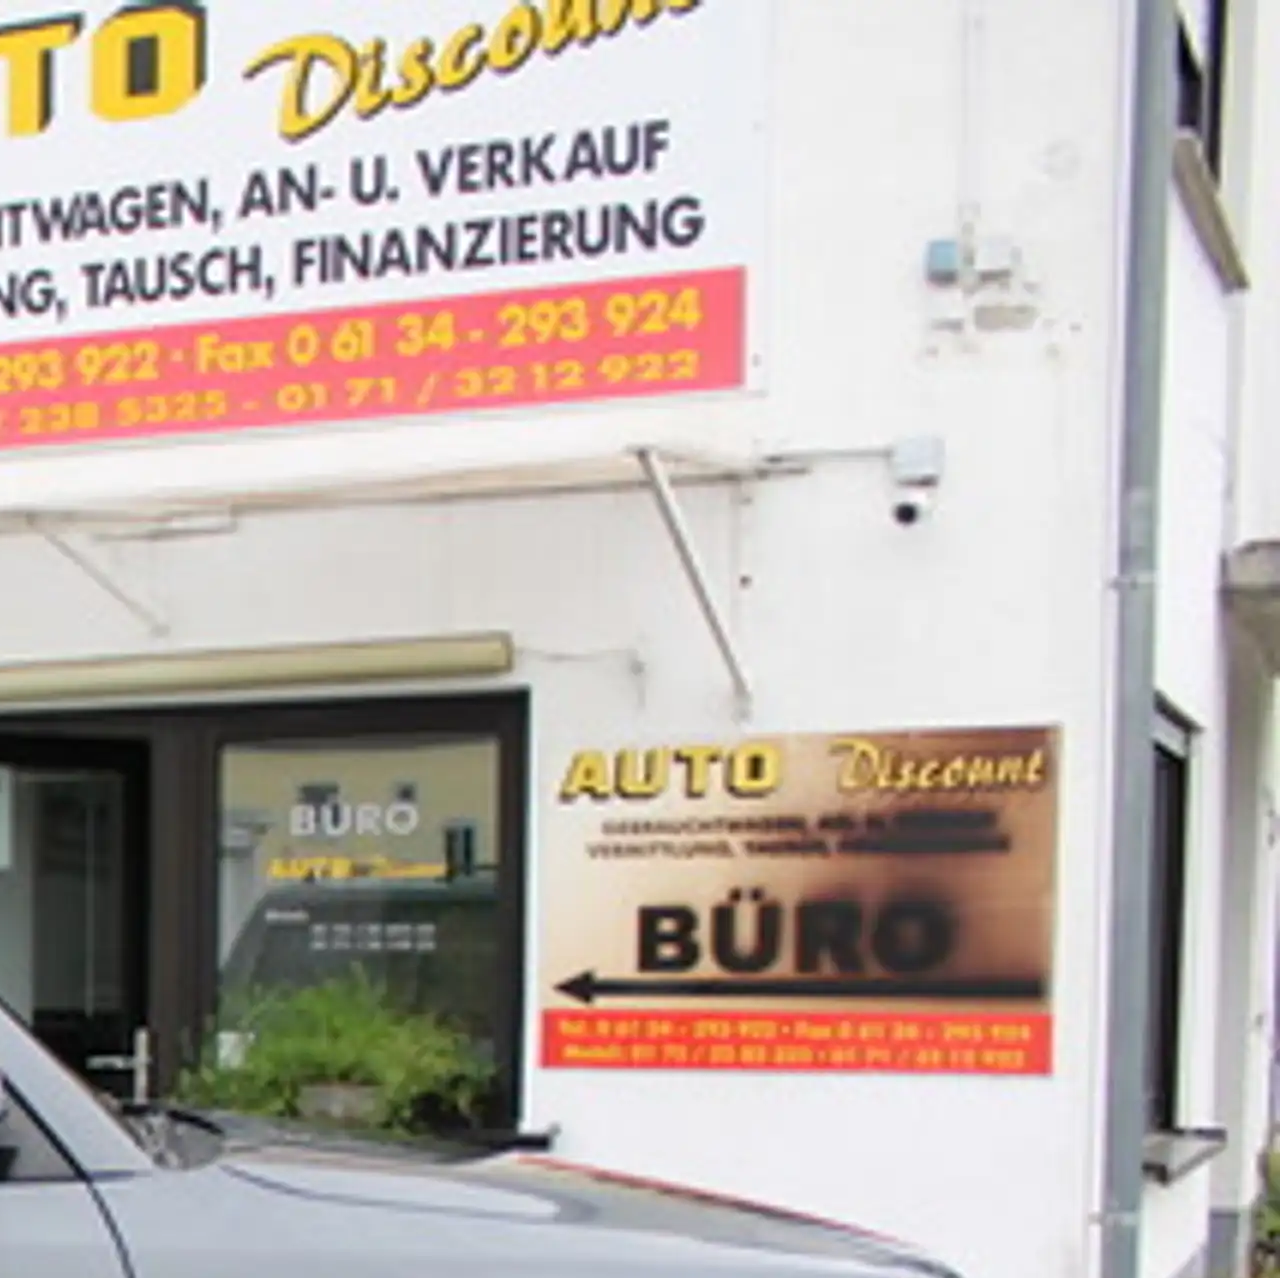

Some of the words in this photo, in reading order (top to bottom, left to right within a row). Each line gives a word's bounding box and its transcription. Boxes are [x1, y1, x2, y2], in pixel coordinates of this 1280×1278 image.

[240, 164, 336, 218] AN-
[349, 155, 400, 205] U.
[415, 118, 670, 197] VERKAUF
[82, 245, 274, 307] TAUSCH,
[294, 195, 705, 287] FINANZIERUNG
[75, 340, 160, 386] 922
[195, 333, 275, 374] Fax
[287, 323, 318, 366] 0
[332, 319, 377, 362] 61
[396, 311, 456, 357] 34
[498, 298, 588, 345] 293
[606, 287, 702, 337] 924
[276, 382, 328, 411] 01
[346, 376, 397, 406] 71
[529, 358, 584, 390] 12
[558, 742, 782, 803] AUTO
[828, 738, 1045, 792] Discount
[637, 886, 960, 974] BÜRO
